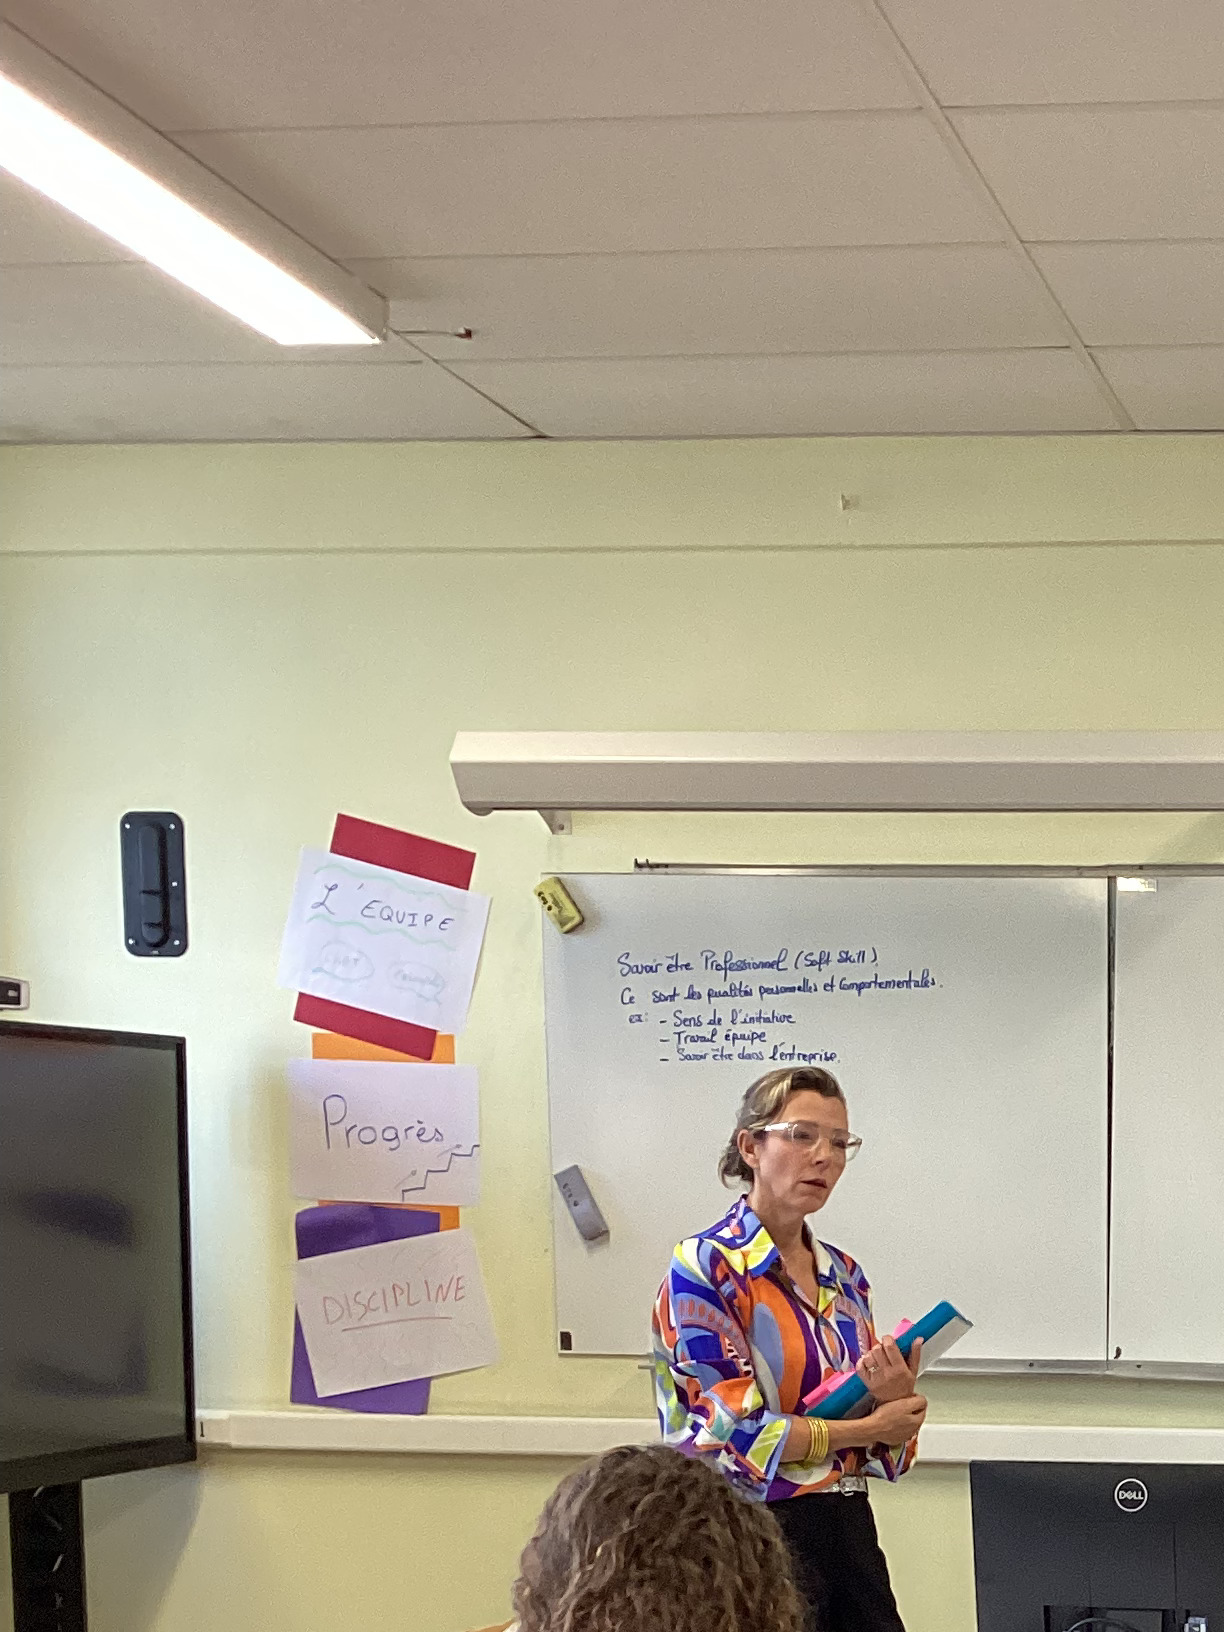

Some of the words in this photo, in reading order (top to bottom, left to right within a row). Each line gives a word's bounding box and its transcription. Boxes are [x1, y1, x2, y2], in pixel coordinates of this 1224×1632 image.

[617, 952, 662, 977] Savoir
[701, 948, 789, 982] Professionnel
[620, 987, 636, 1005] Ce
[651, 986, 680, 1004] sont
[823, 974, 836, 992] et
[673, 1009, 703, 1027] Sens
[707, 1008, 722, 1026] de
[673, 1028, 717, 1045] Travail
[738, 1046, 764, 1061] dans
[323, 1094, 444, 1151] Progrès
[323, 1275, 466, 1325] DISCIPLINE
[1118, 1490, 1144, 1500] DELL
